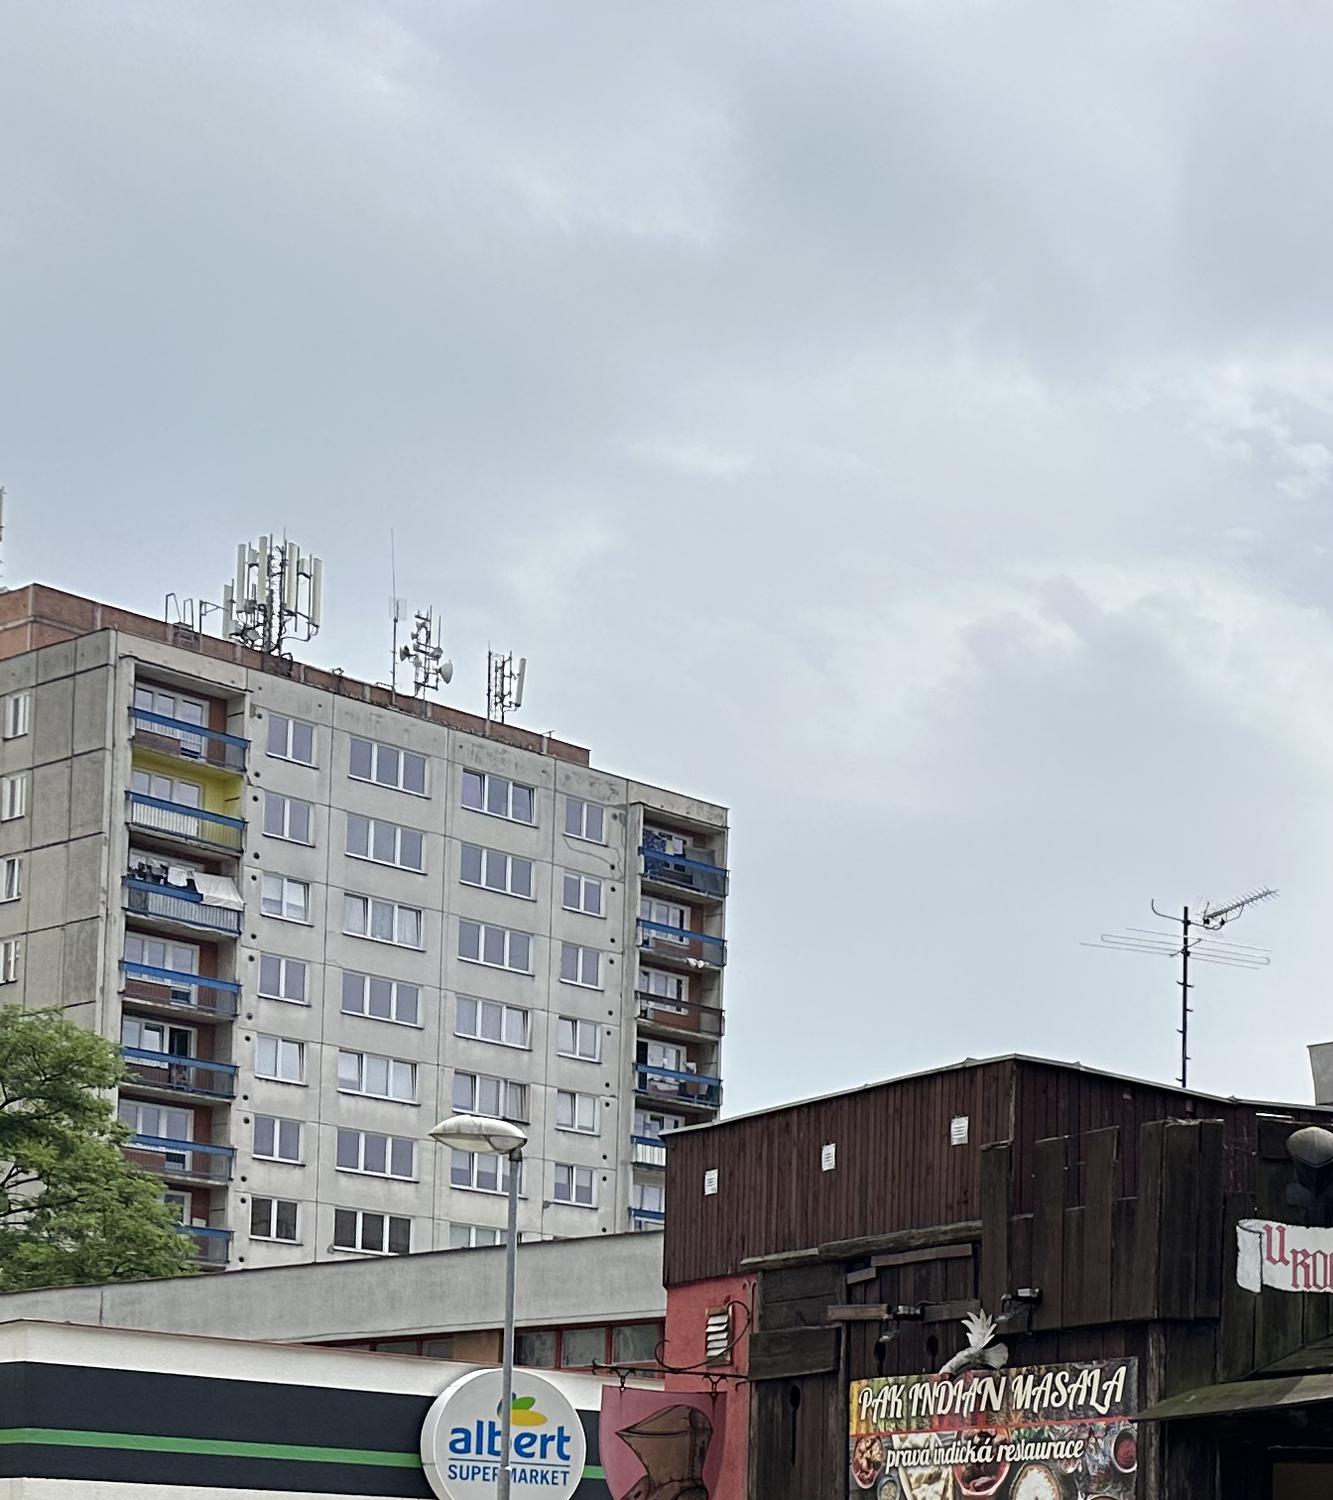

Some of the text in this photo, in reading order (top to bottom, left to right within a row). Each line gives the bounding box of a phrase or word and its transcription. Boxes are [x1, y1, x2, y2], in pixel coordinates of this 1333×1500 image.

[858, 1365, 1128, 1423] PAK INDIAN MASALA
[448, 1419, 571, 1461] albert
[885, 1436, 1084, 1474] pravá indická restaurace
